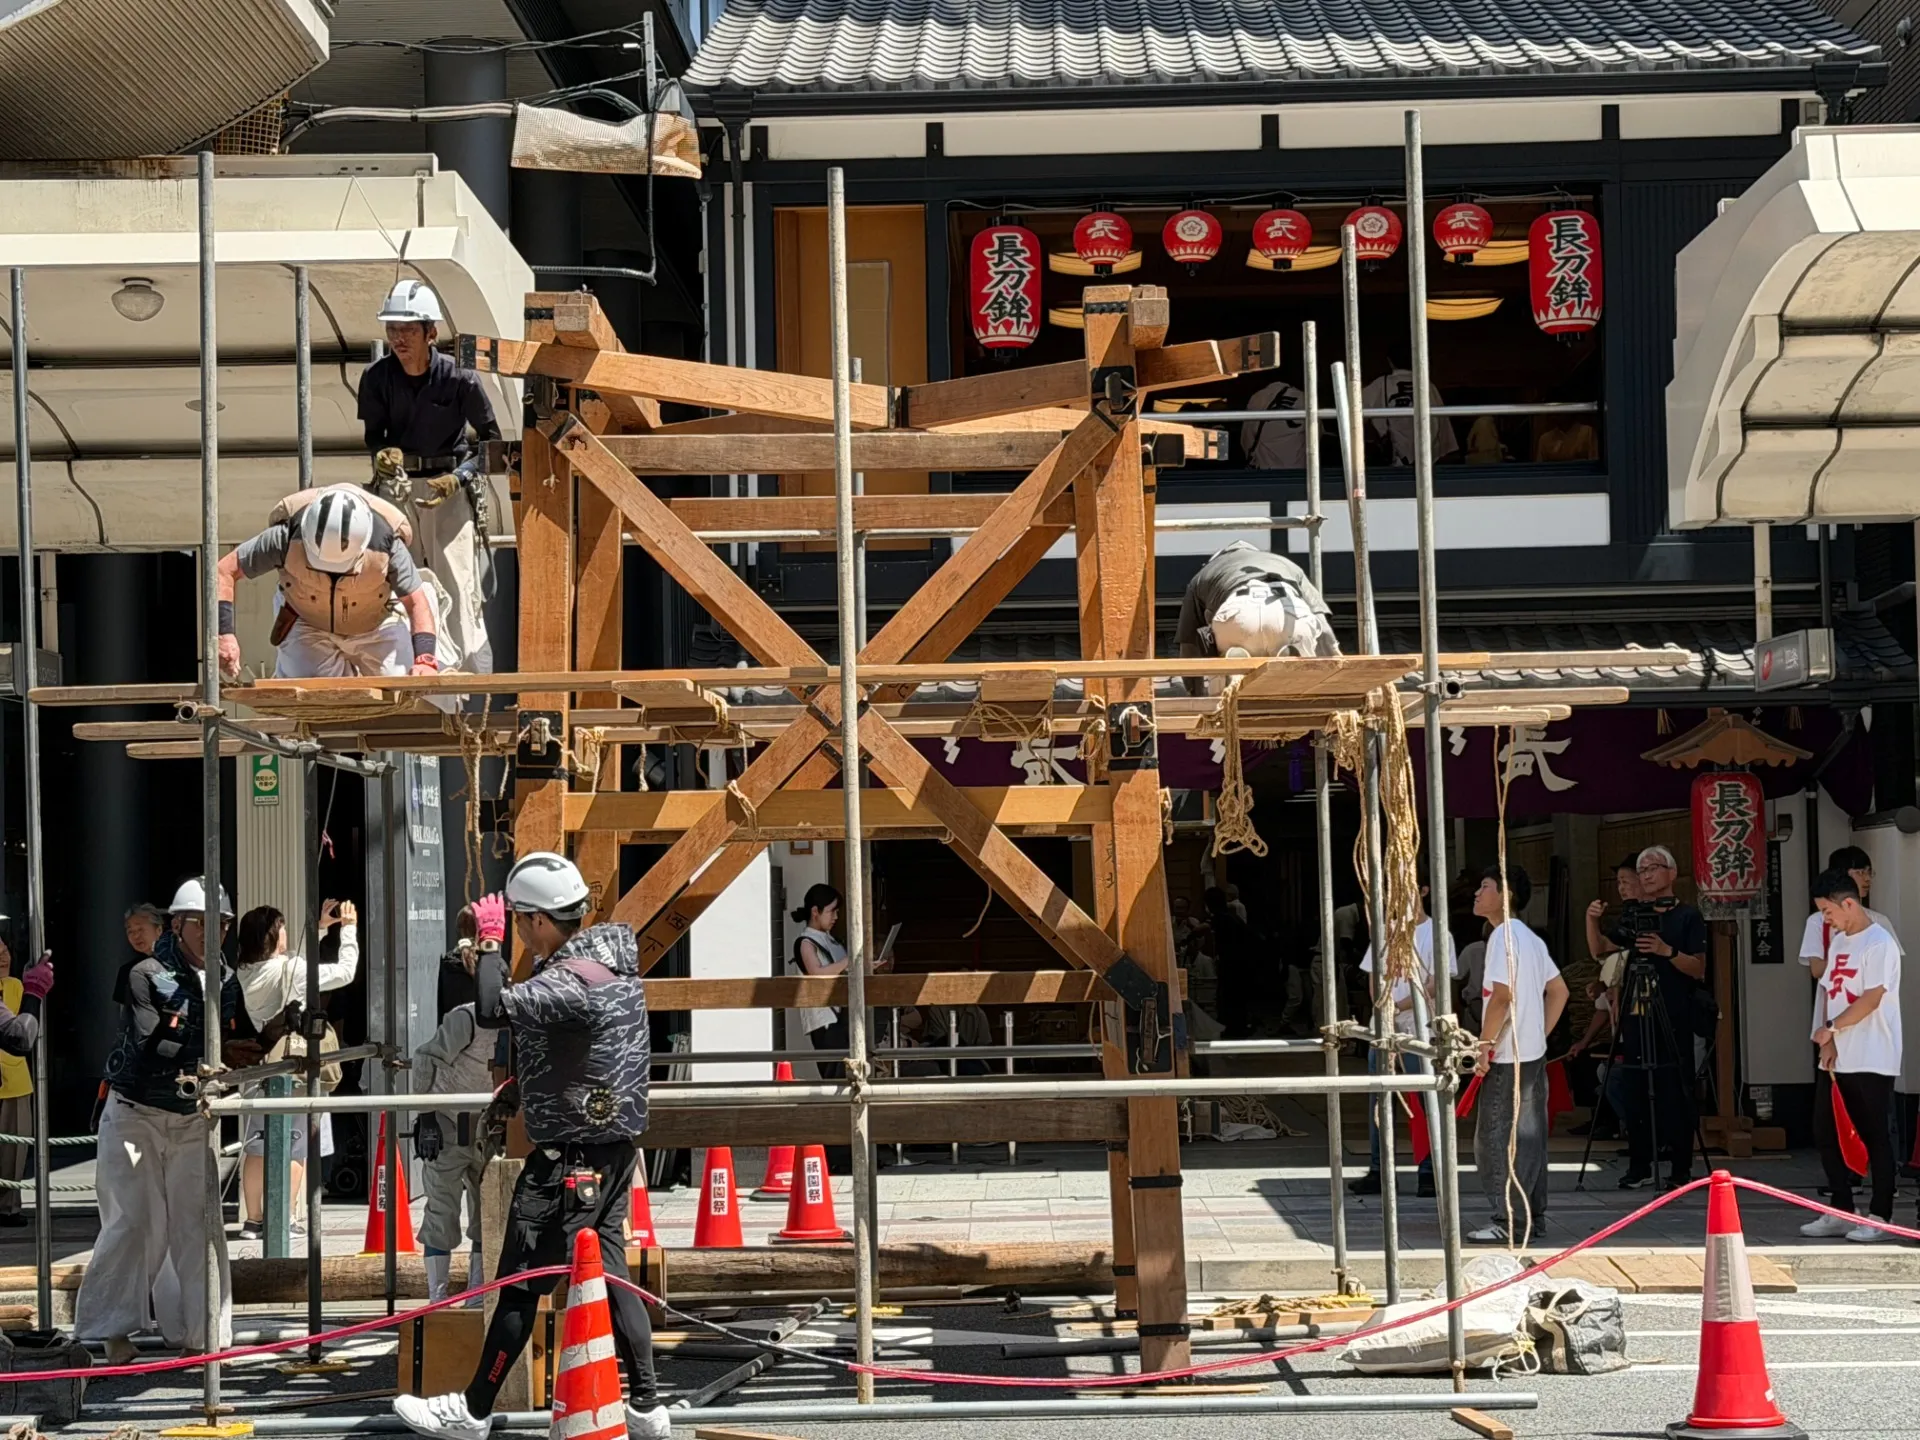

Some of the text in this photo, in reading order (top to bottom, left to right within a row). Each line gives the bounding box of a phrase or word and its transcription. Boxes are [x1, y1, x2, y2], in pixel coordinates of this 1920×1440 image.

[1086, 219, 1120, 240] 長
[1265, 218, 1297, 241] 長
[1447, 211, 1480, 230] 長
[979, 233, 1036, 334] 長刀鉾
[1546, 215, 1593, 315] 長刀鉾
[1707, 781, 1757, 882] 長刀鉾
[712, 1172, 727, 1213] 祇園祭
[807, 1161, 822, 1203] 祇園祭
